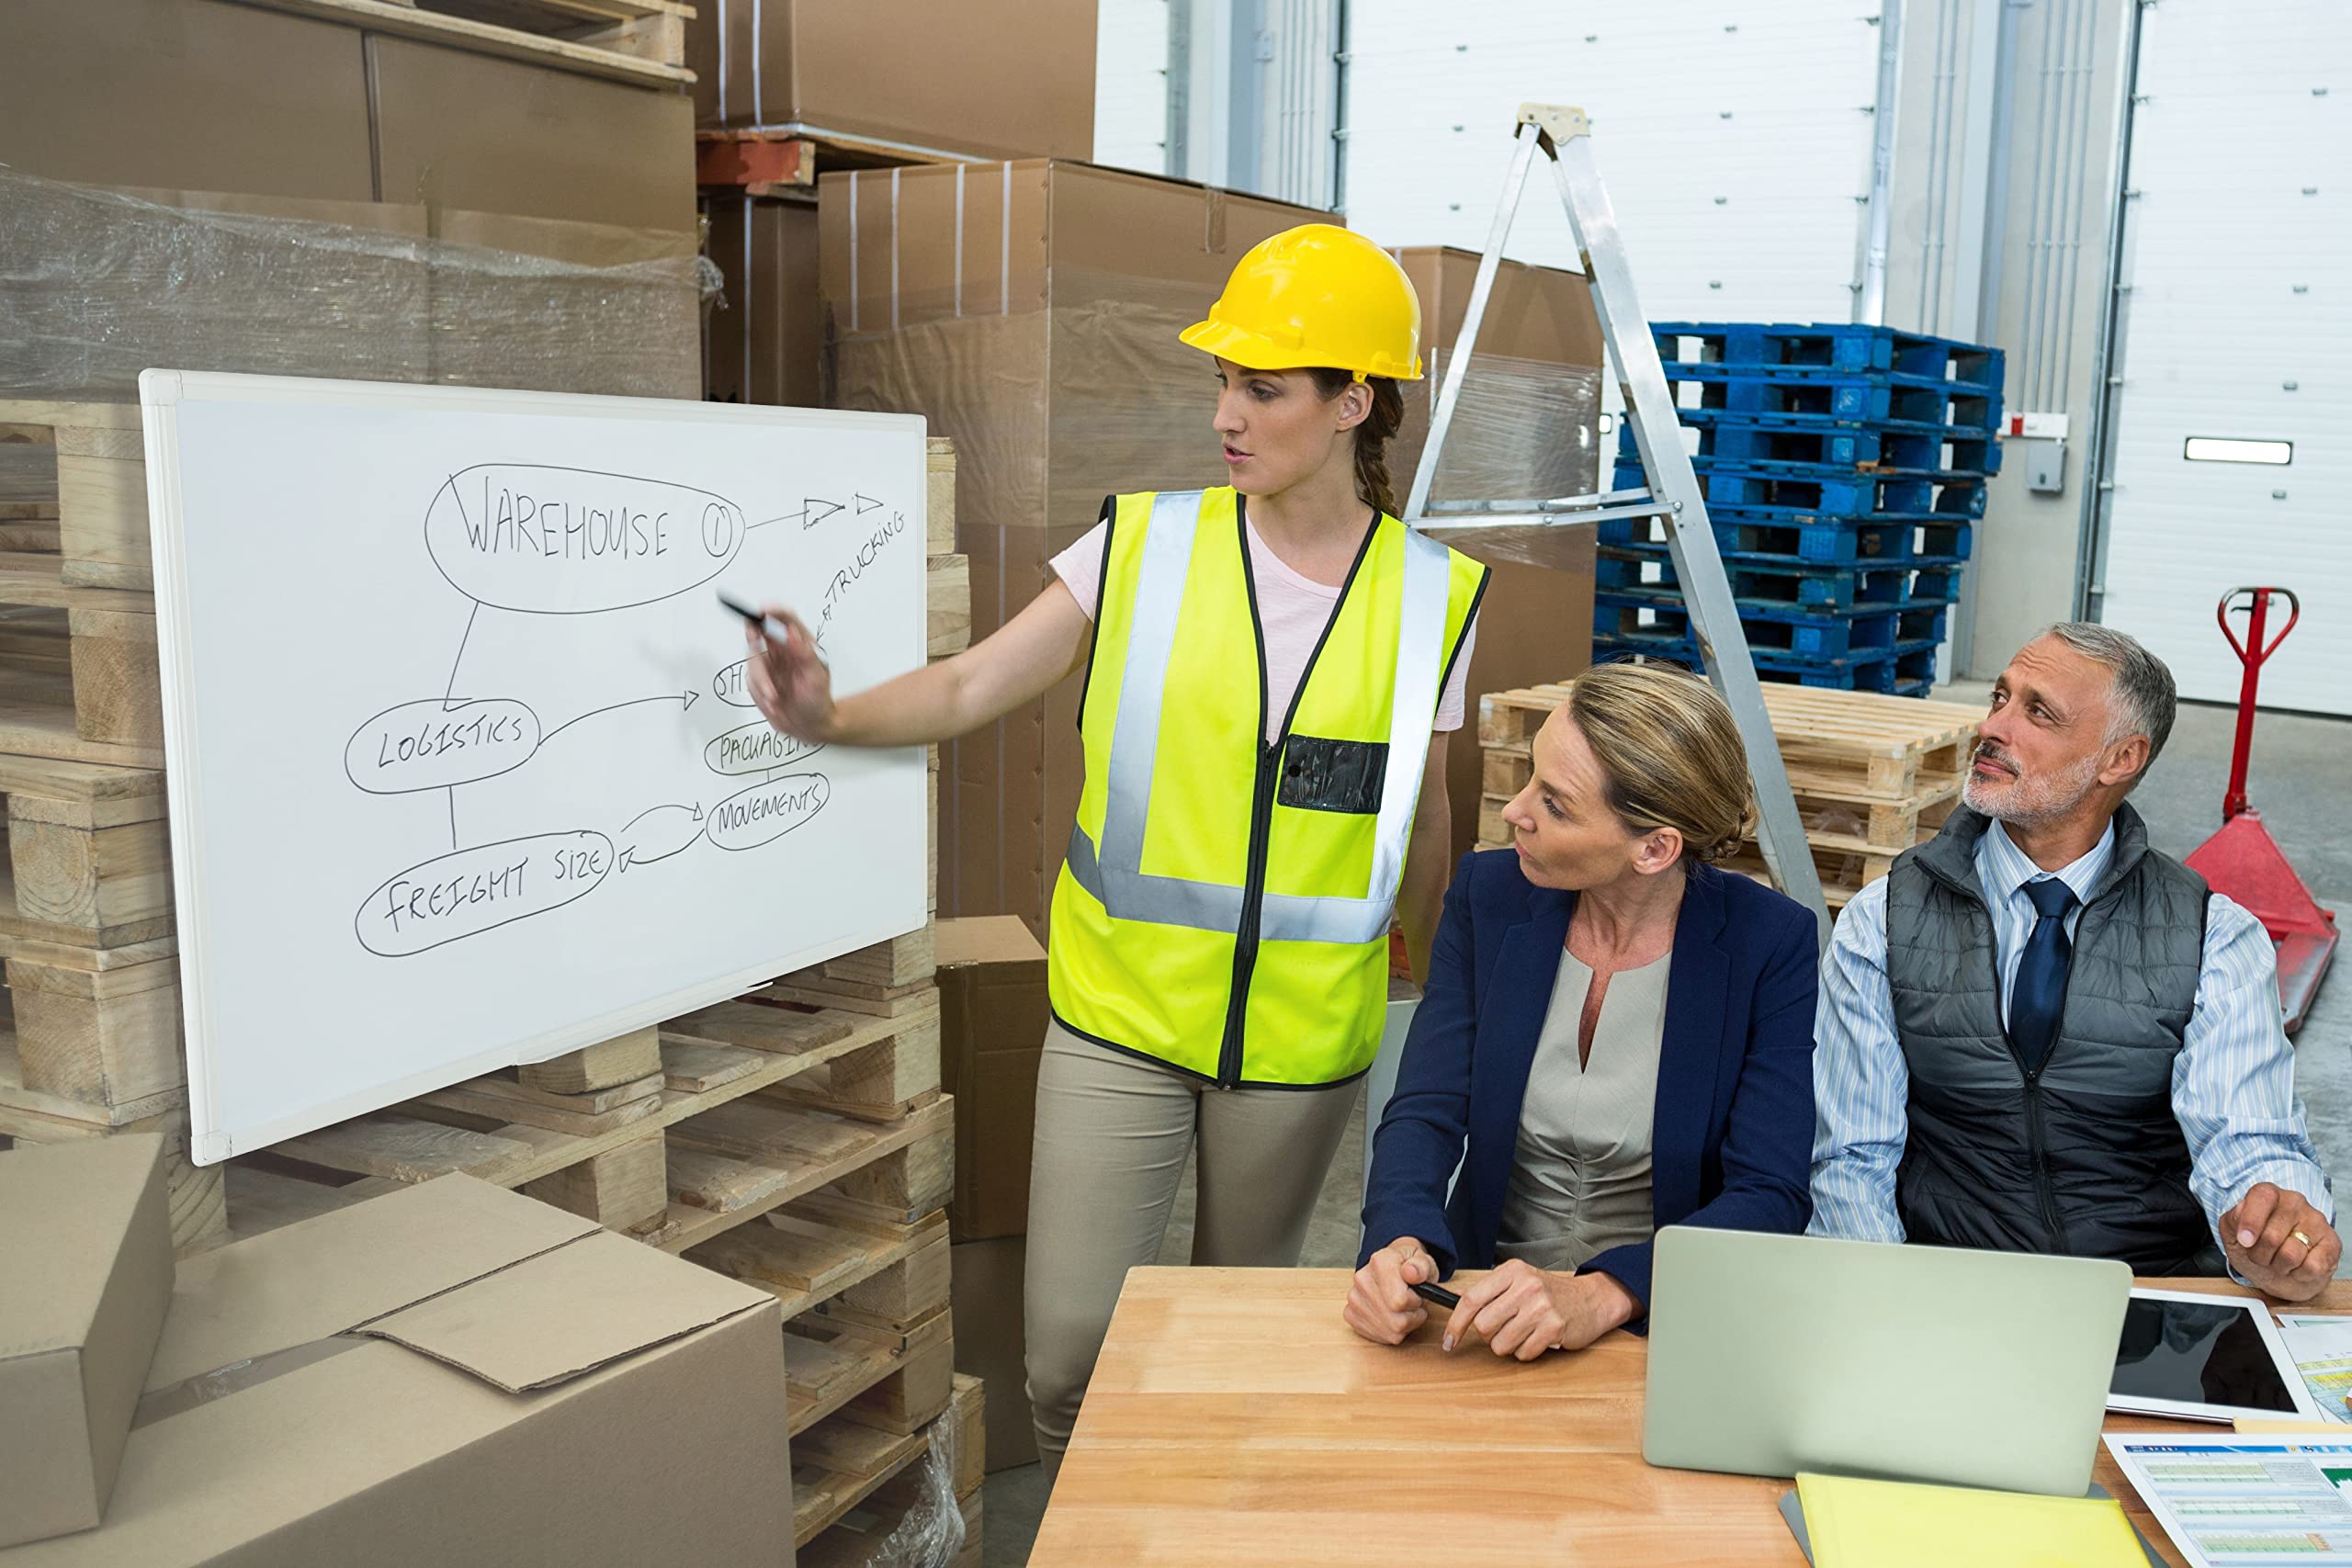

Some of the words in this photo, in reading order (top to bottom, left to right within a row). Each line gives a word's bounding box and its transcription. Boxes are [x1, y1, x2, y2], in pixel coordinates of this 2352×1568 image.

[448, 474, 669, 560] WAREHOUSE
[379, 714, 522, 768] LOGISTICS
[720, 731, 820, 769] PACKAGI
[718, 784, 820, 833] MOVEMENTS
[384, 857, 528, 932] FREIGHT
